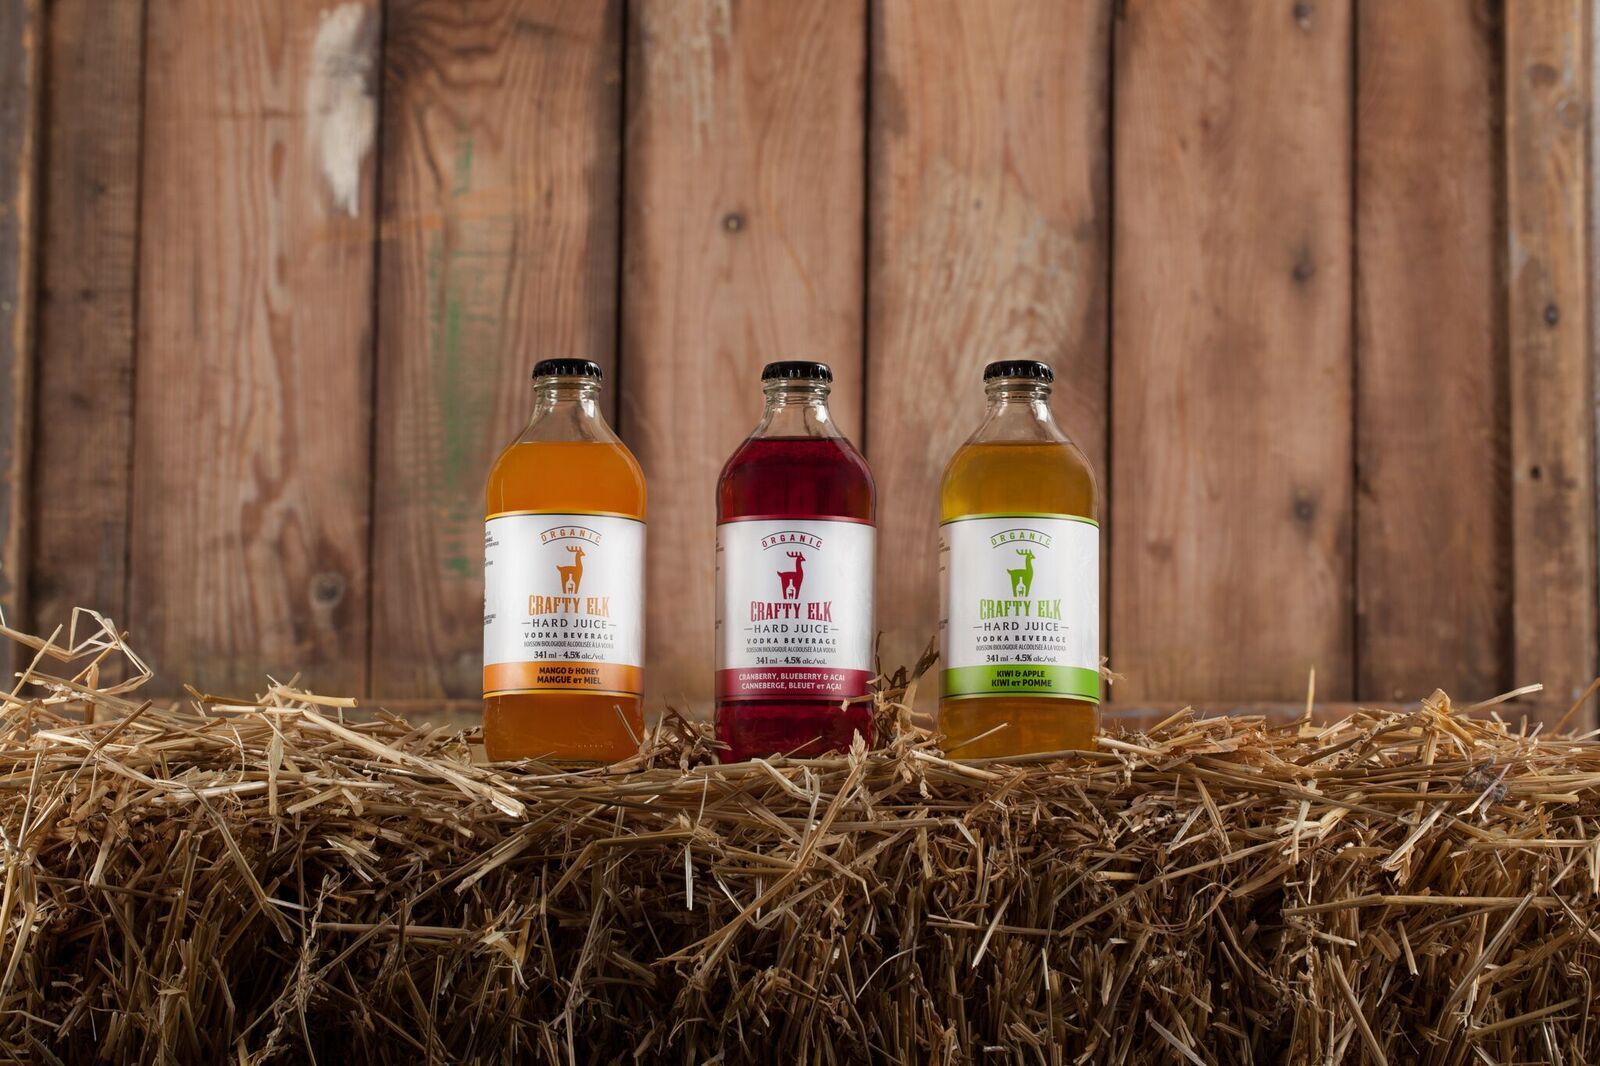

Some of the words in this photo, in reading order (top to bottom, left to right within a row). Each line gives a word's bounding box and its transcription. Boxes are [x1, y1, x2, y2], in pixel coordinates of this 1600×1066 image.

[541, 528, 602, 543] ORGANIC
[991, 531, 1051, 546] ORGANIC
[762, 533, 822, 549] ORGANIC
[529, 595, 580, 616] CRAFTY
[587, 596, 610, 617] ELK
[980, 599, 1031, 620] CRAFTY
[1038, 599, 1061, 620] ELK
[751, 601, 801, 622] CRAFTY
[808, 601, 832, 622] ELK
[533, 619, 568, 628] HARD
[573, 619, 607, 629] JUICE
[755, 624, 788, 633] HARD
[794, 624, 828, 633] JUICE
[984, 622, 1019, 631] HARD
[1025, 622, 1058, 631] JUICE
[785, 637, 836, 645] BEVERAGE
[534, 651, 547, 659] 341
[563, 651, 580, 659] 4.5%
[742, 682, 786, 690] CANNEBERGE,
[826, 683, 842, 691] AÇAI
[992, 679, 1010, 687] KIWI
